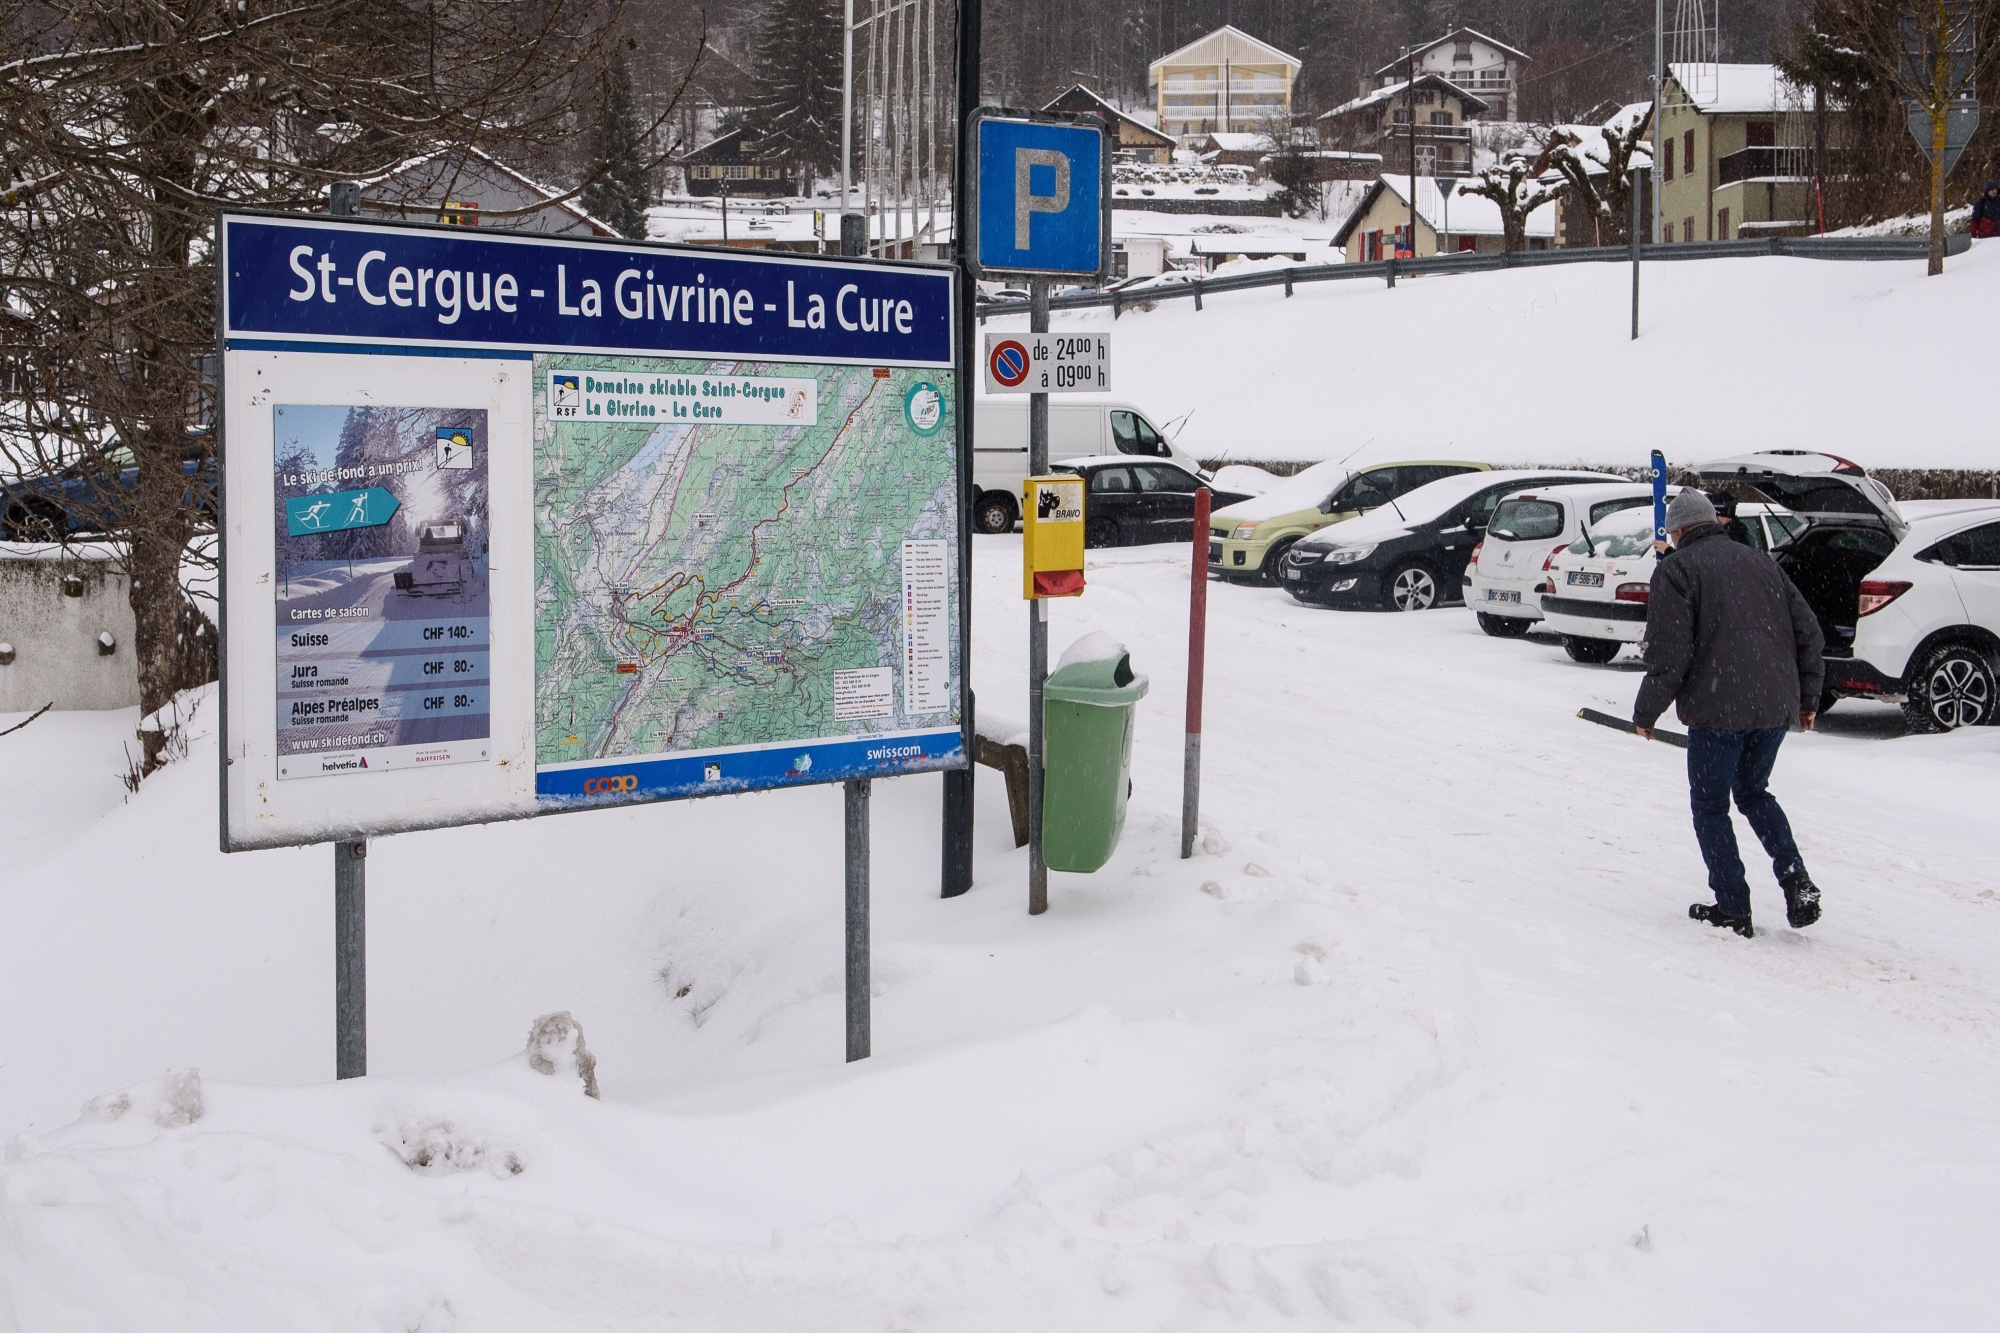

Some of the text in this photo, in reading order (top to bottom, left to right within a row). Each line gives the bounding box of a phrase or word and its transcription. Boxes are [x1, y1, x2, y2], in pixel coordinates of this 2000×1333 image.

[1015, 147, 1070, 250] P
[289, 245, 518, 325] St-Cergue
[558, 264, 602, 317] La
[614, 269, 754, 325] Givrine
[788, 280, 825, 329] La
[836, 284, 913, 334] Cure
[1033, 339, 1048, 360] de
[1098, 339, 1104, 359] h
[1042, 369, 1048, 387] à
[1098, 365, 1105, 386] h
[585, 376, 785, 402] Domaine skiable Saint-Cergue
[586, 399, 600, 415] La
[607, 399, 655, 416] Givrine
[674, 401, 687, 417] La
[693, 402, 722, 418] Cure
[283, 459, 423, 486] Le ski de fond a un prix!
[1056, 509, 1080, 518] BRAVO
[291, 606, 369, 619] Cartes de saison
[291, 633, 328, 647] Suisse
[423, 626, 474, 640] CHF 140.-
[291, 665, 317, 678] Jura
[424, 660, 474, 675] CHF 80.-
[292, 677, 348, 688] Suisse romande
[292, 698, 379, 716] Alpes Préalpes
[424, 695, 474, 710] CHF 80.-
[292, 714, 349, 725] Suisse romande
[292, 733, 384, 750] www.skidefond.ch
[416, 754, 451, 762] RAIFFEISEN
[867, 744, 921, 760] swisscom
[323, 761, 357, 771] helvetia
[584, 775, 637, 795] coop
